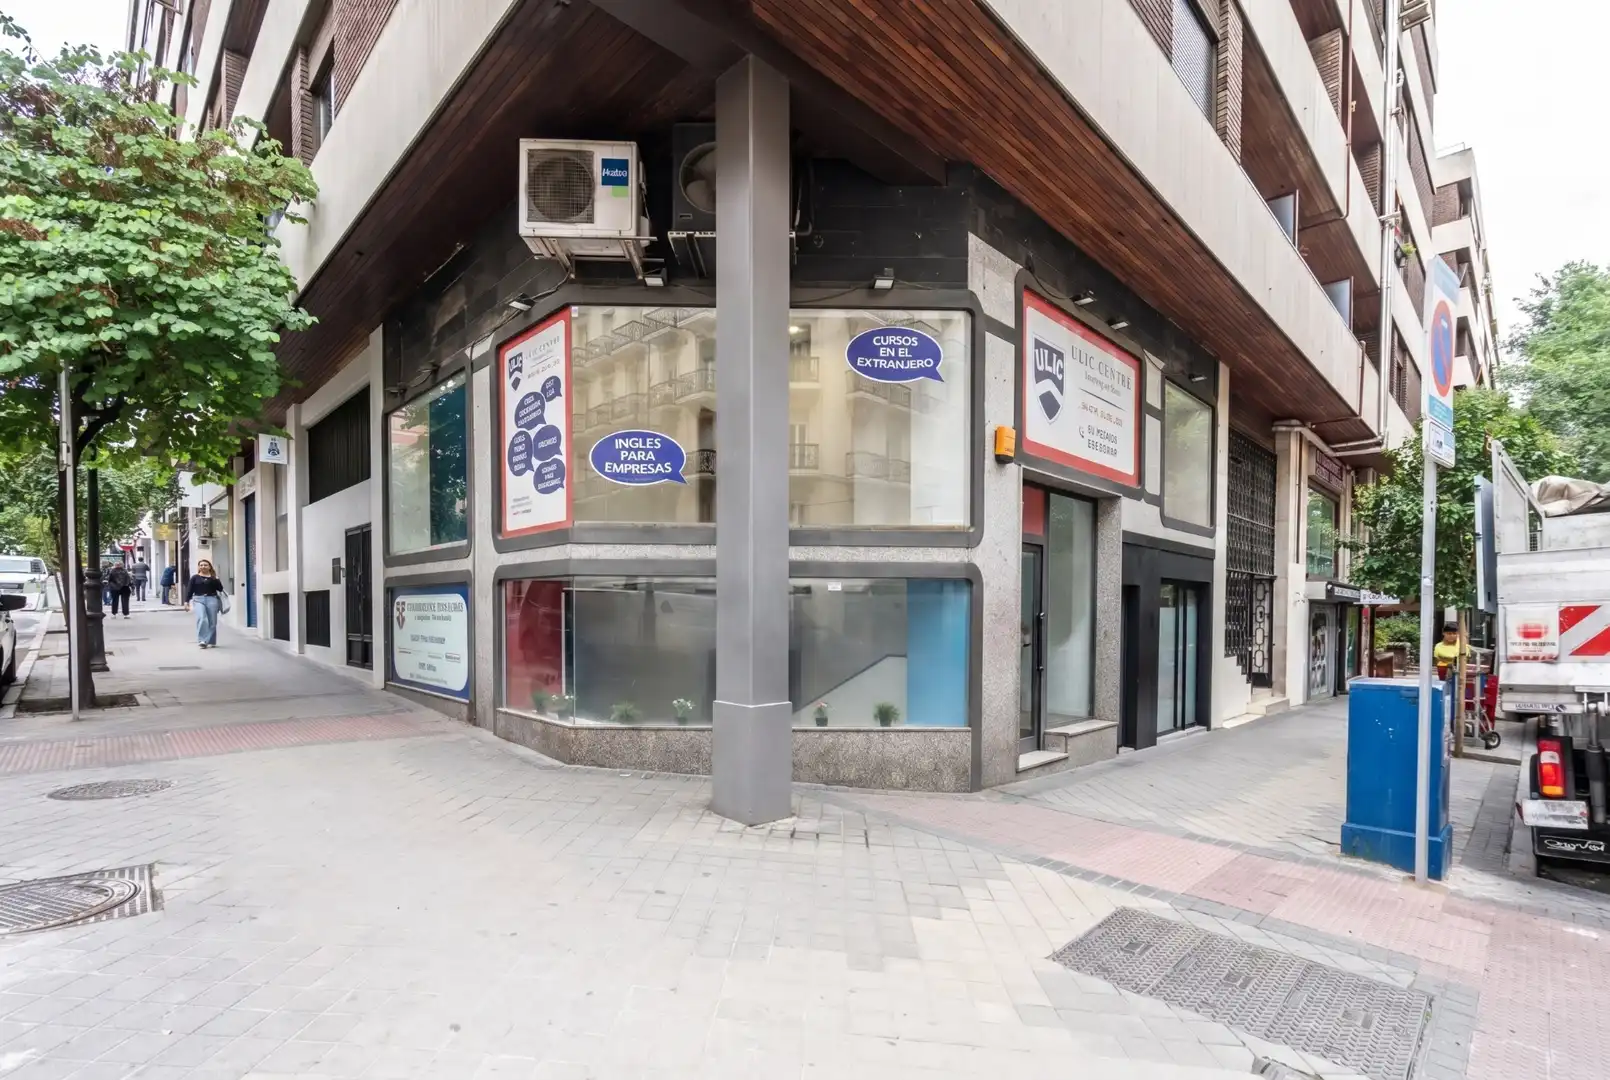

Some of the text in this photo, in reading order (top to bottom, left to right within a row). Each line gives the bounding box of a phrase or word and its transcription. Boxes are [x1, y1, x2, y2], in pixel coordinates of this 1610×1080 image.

[873, 335, 919, 347] CURSOS
[880, 347, 912, 358] EN EL
[857, 357, 934, 369] EXTRANJERO
[1035, 347, 1064, 381] ULIC
[1071, 345, 1095, 370] ULIC
[1098, 361, 1132, 391] CENTRE
[615, 437, 662, 449] INGLES
[620, 451, 656, 461] PARA
[604, 461, 672, 474] EMPRESAS
